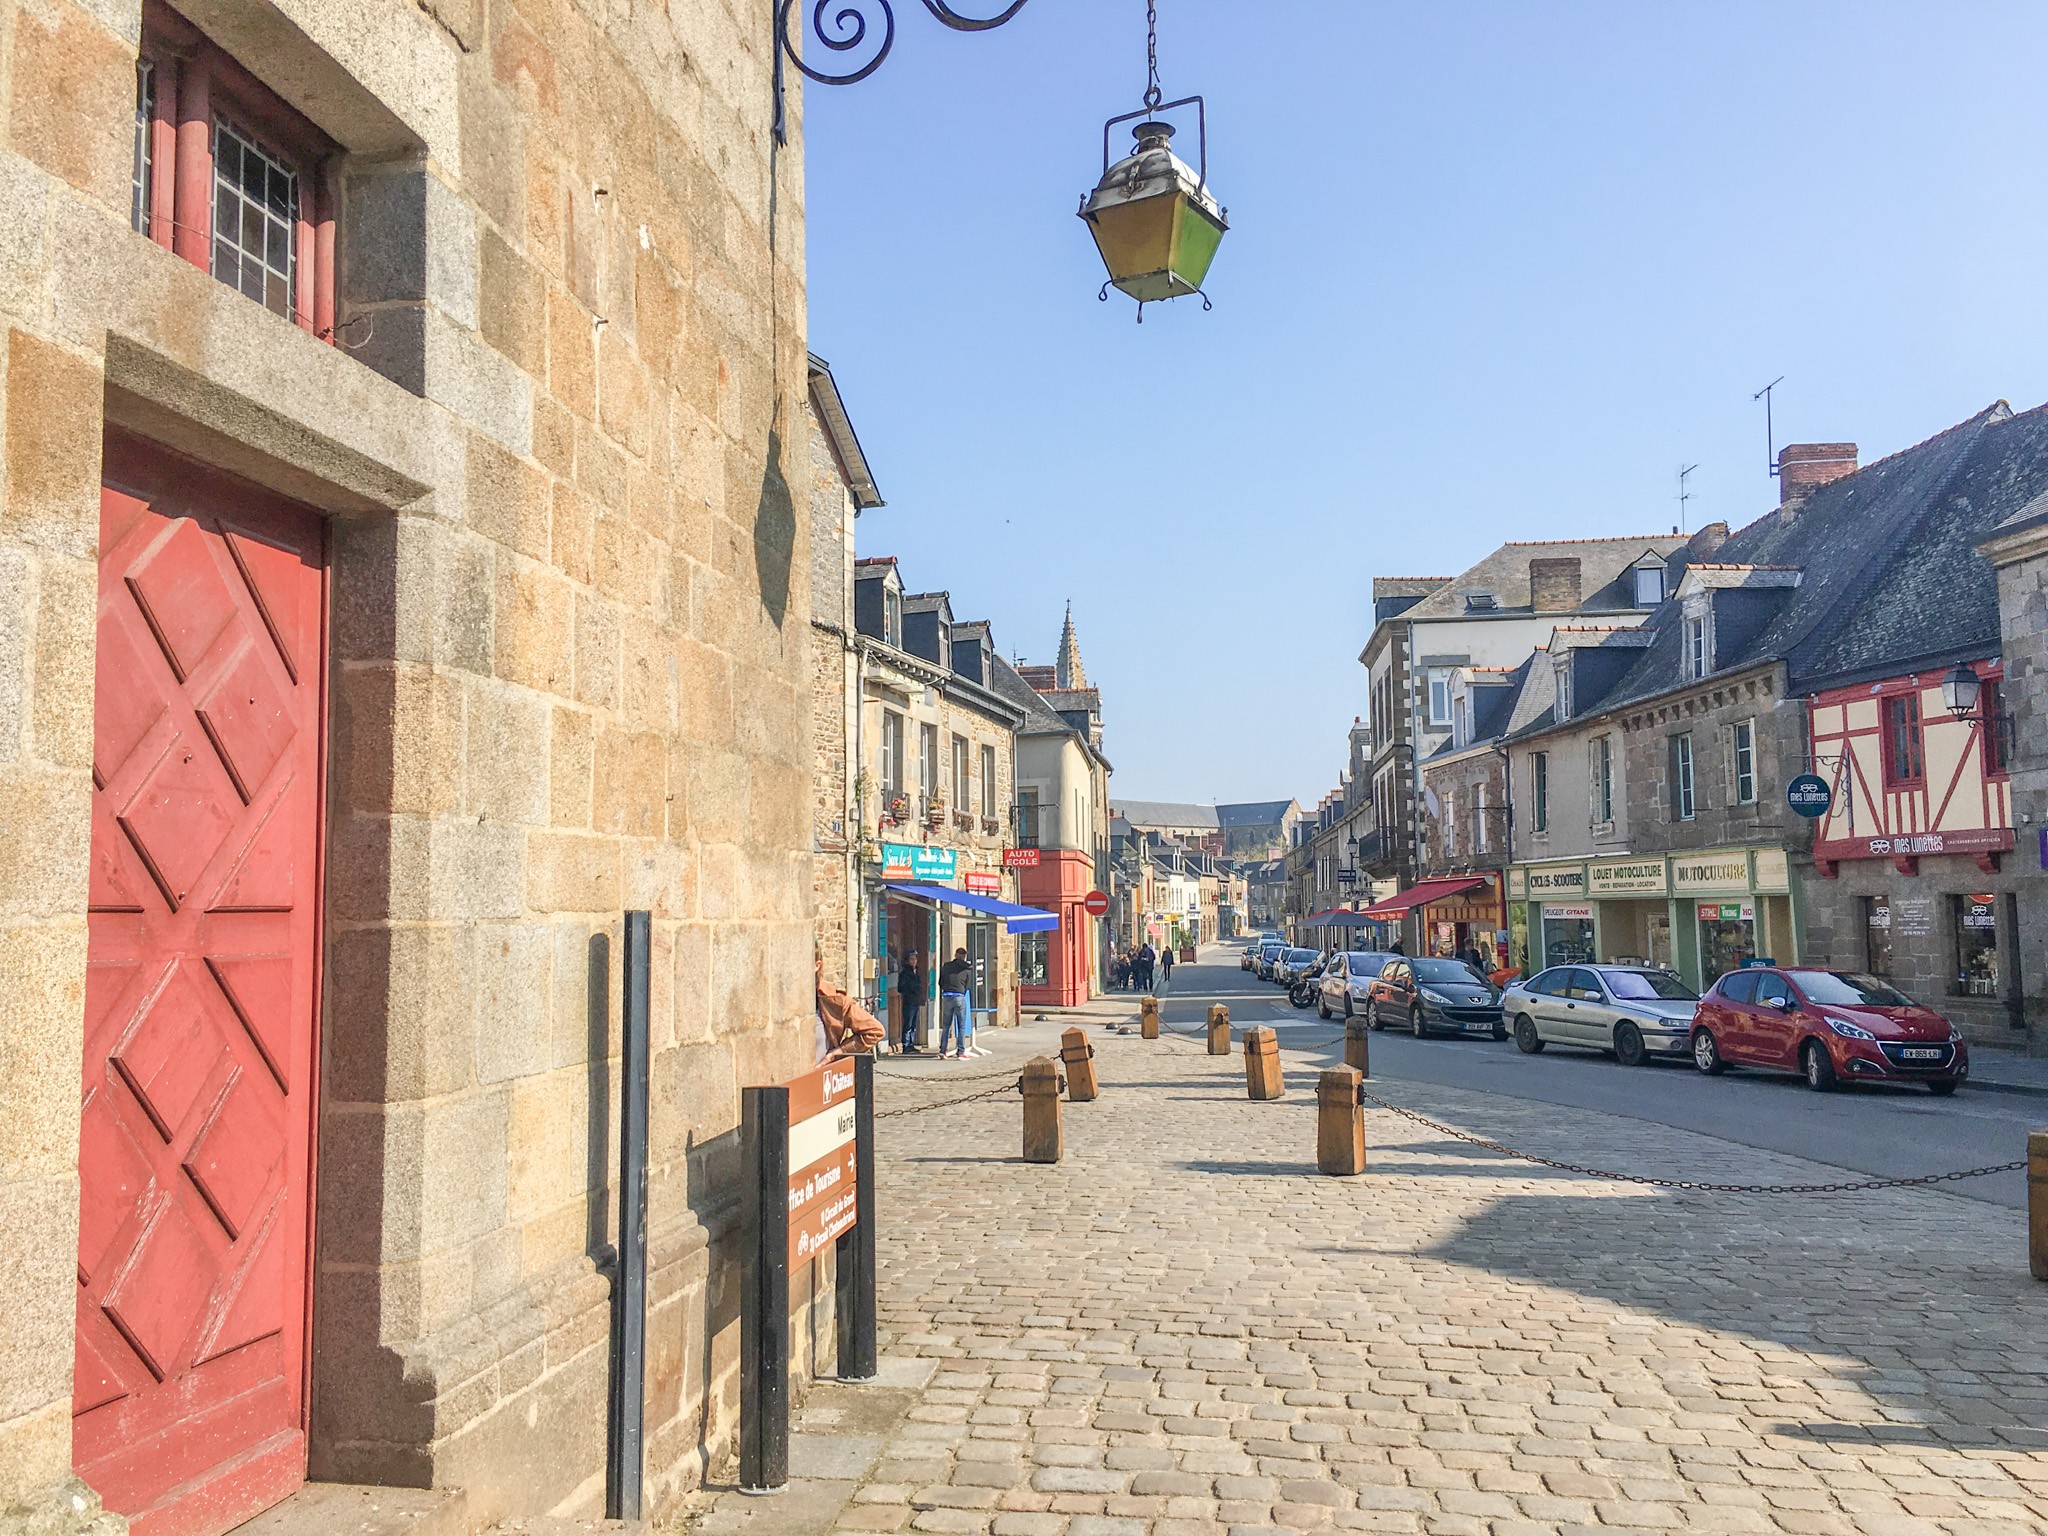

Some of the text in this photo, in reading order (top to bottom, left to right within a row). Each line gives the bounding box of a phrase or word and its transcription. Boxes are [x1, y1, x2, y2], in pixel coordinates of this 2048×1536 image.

[1006, 858, 1038, 866] ECOLE
[1008, 850, 1035, 858] AUTO
[1593, 864, 1662, 880] LOUET MOTOCULTURE
[1677, 863, 1747, 882] MOTOCULTURE
[1545, 908, 1564, 916] PEUGEOT
[1701, 908, 1717, 917] STIHL
[832, 1071, 854, 1095] Château
[837, 1111, 854, 1136] Mairie
[788, 1166, 841, 1212] ffice de Tourisme
[815, 1226, 828, 1249] Circuit
